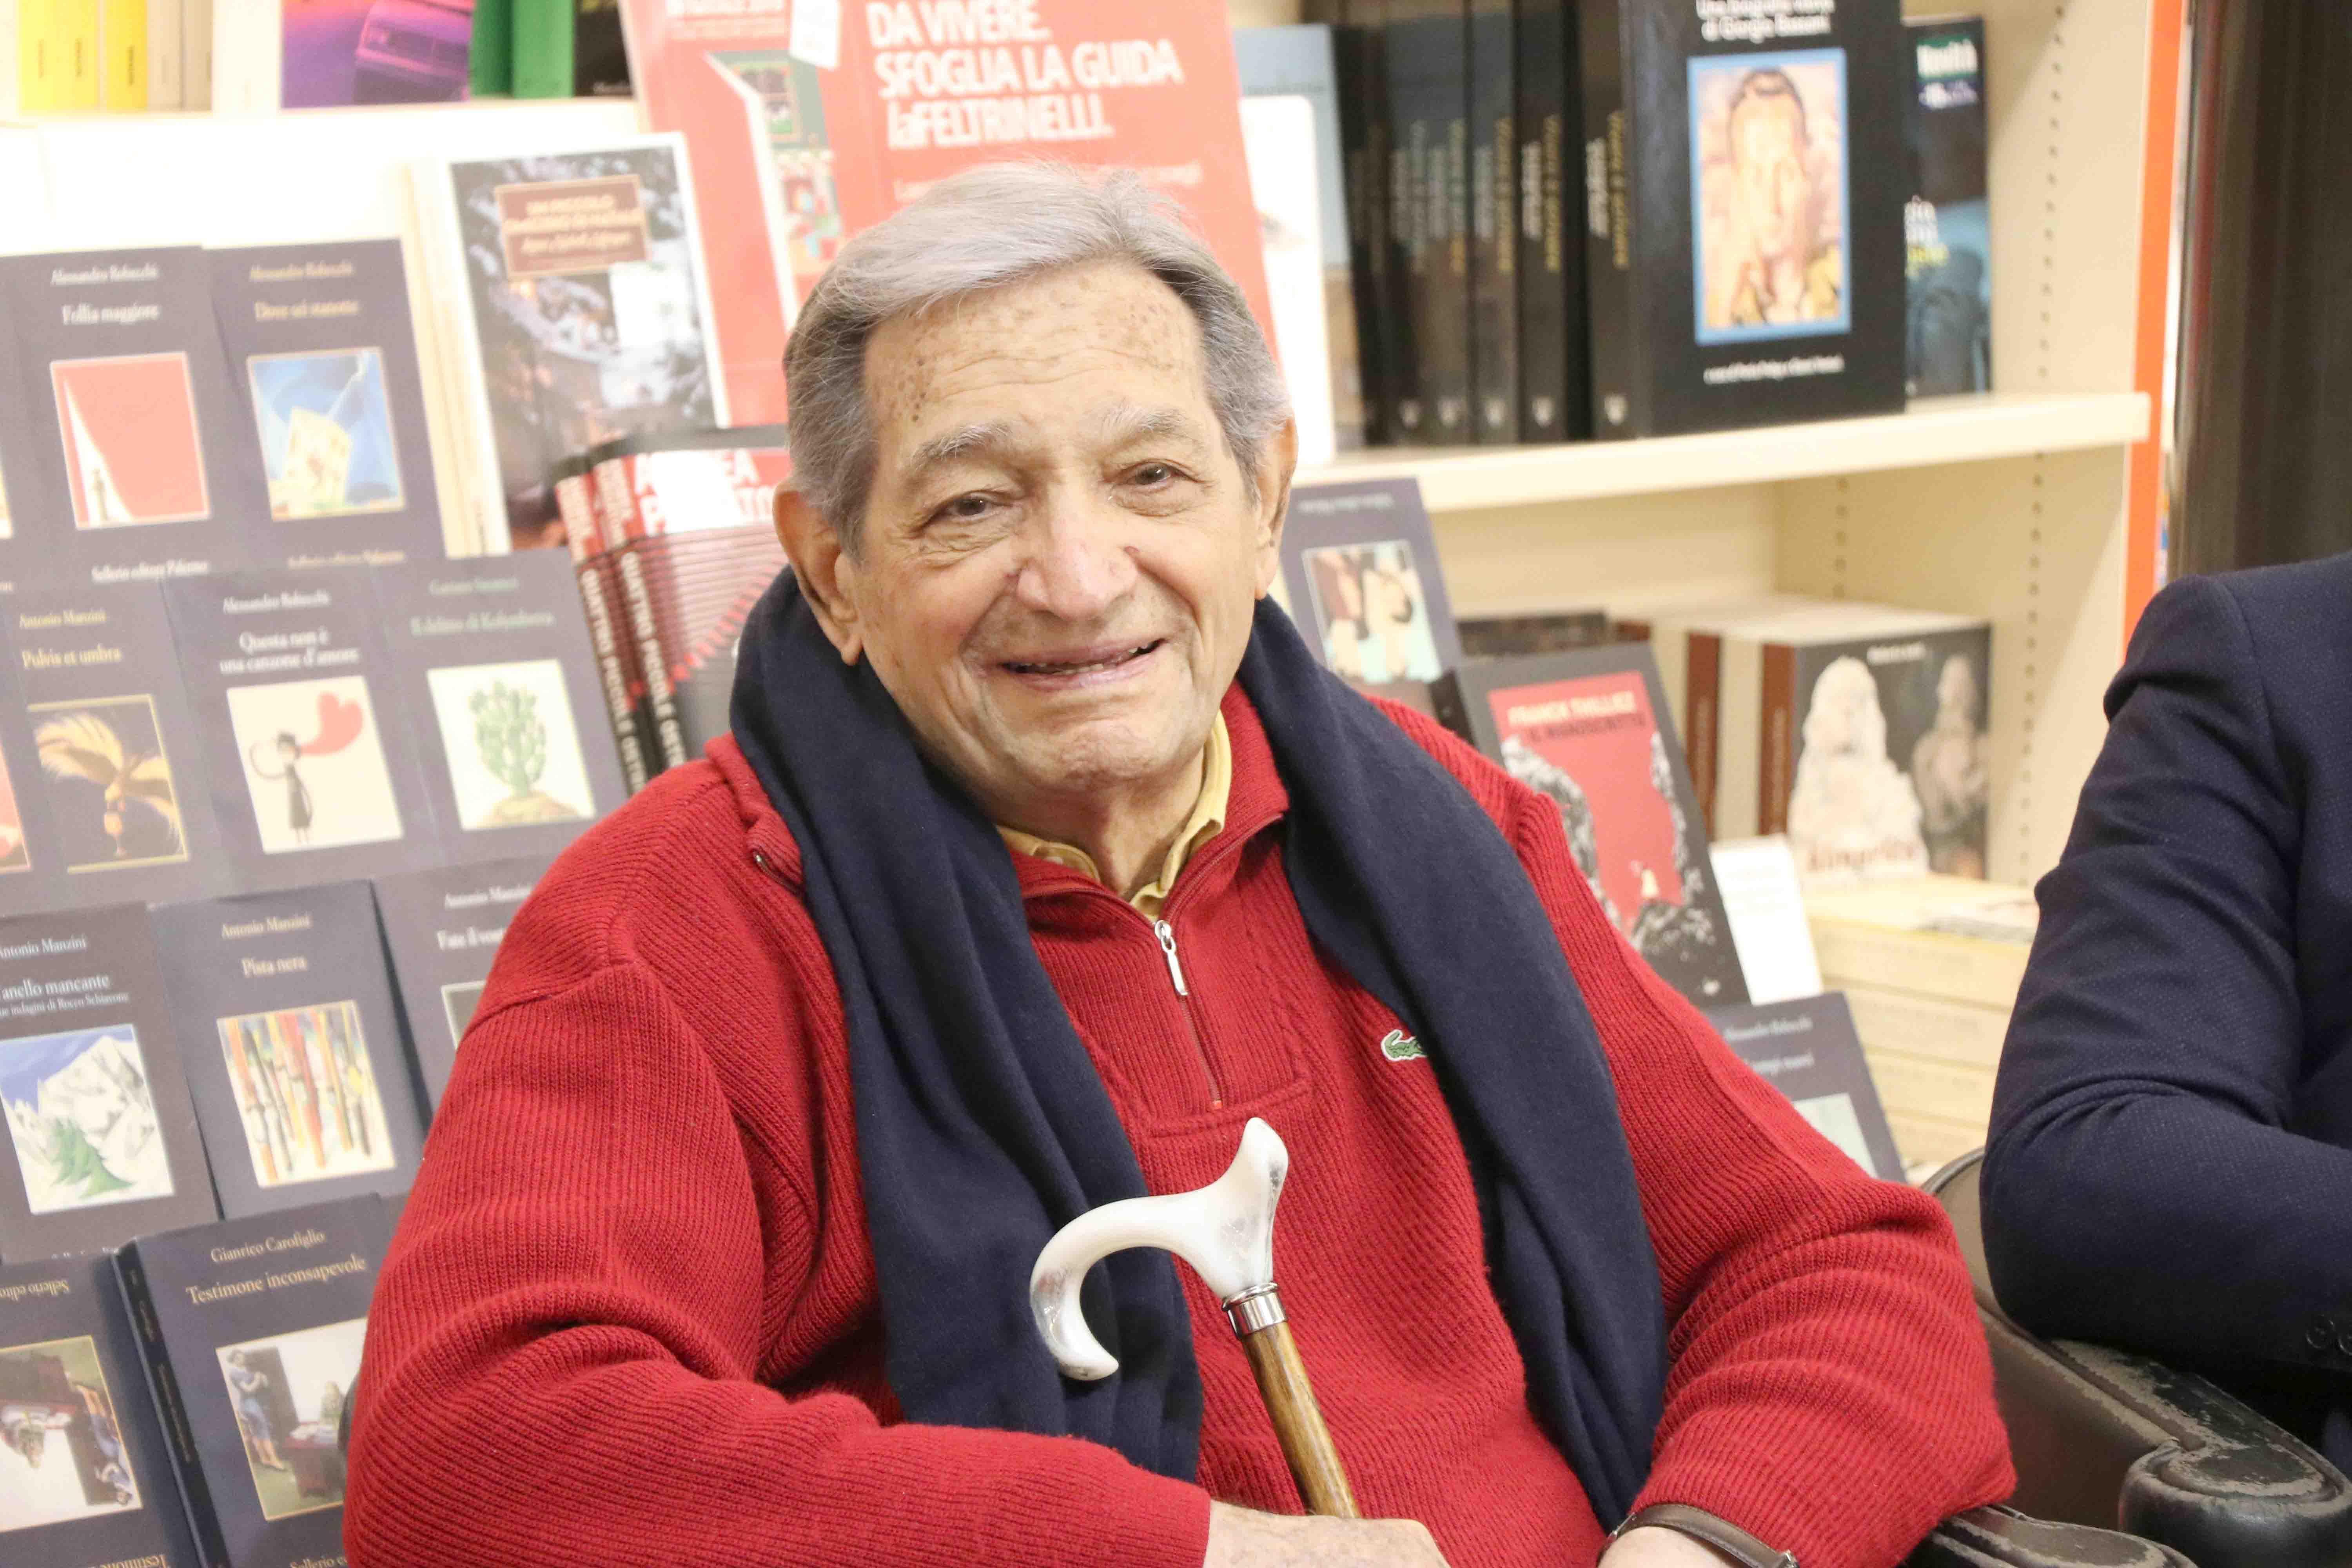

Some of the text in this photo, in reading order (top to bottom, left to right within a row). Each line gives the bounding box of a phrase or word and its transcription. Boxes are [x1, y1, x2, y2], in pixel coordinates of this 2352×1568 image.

[866, 0, 1052, 48] DA VIVERE.
[874, 38, 1185, 100] SFOGLIA LA GUIDA
[19, 608, 107, 629] Antonio Manzini
[239, 632, 289, 657] Questa
[290, 632, 316, 648] non
[22, 644, 123, 669] Pulvis et umbra
[220, 659, 245, 675] una
[246, 653, 301, 672] canzone
[445, 890, 489, 909] Antonio
[222, 911, 313, 938] Antonio Manzini
[41, 934, 87, 953] Manzini
[437, 929, 466, 951] Fate
[240, 957, 309, 979] Pista nera
[2, 976, 109, 1000] anello mancante
[11, 1001, 45, 1016] indagini
[47, 999, 57, 1011] di
[57, 998, 84, 1011] Rocco
[211, 1229, 325, 1263] Gianrico Carofiglio
[28, 1279, 69, 1297] Sellerio
[185, 1252, 367, 1305] Testimone inconsapevole
[289, 1556, 334, 1568] Sellerio
